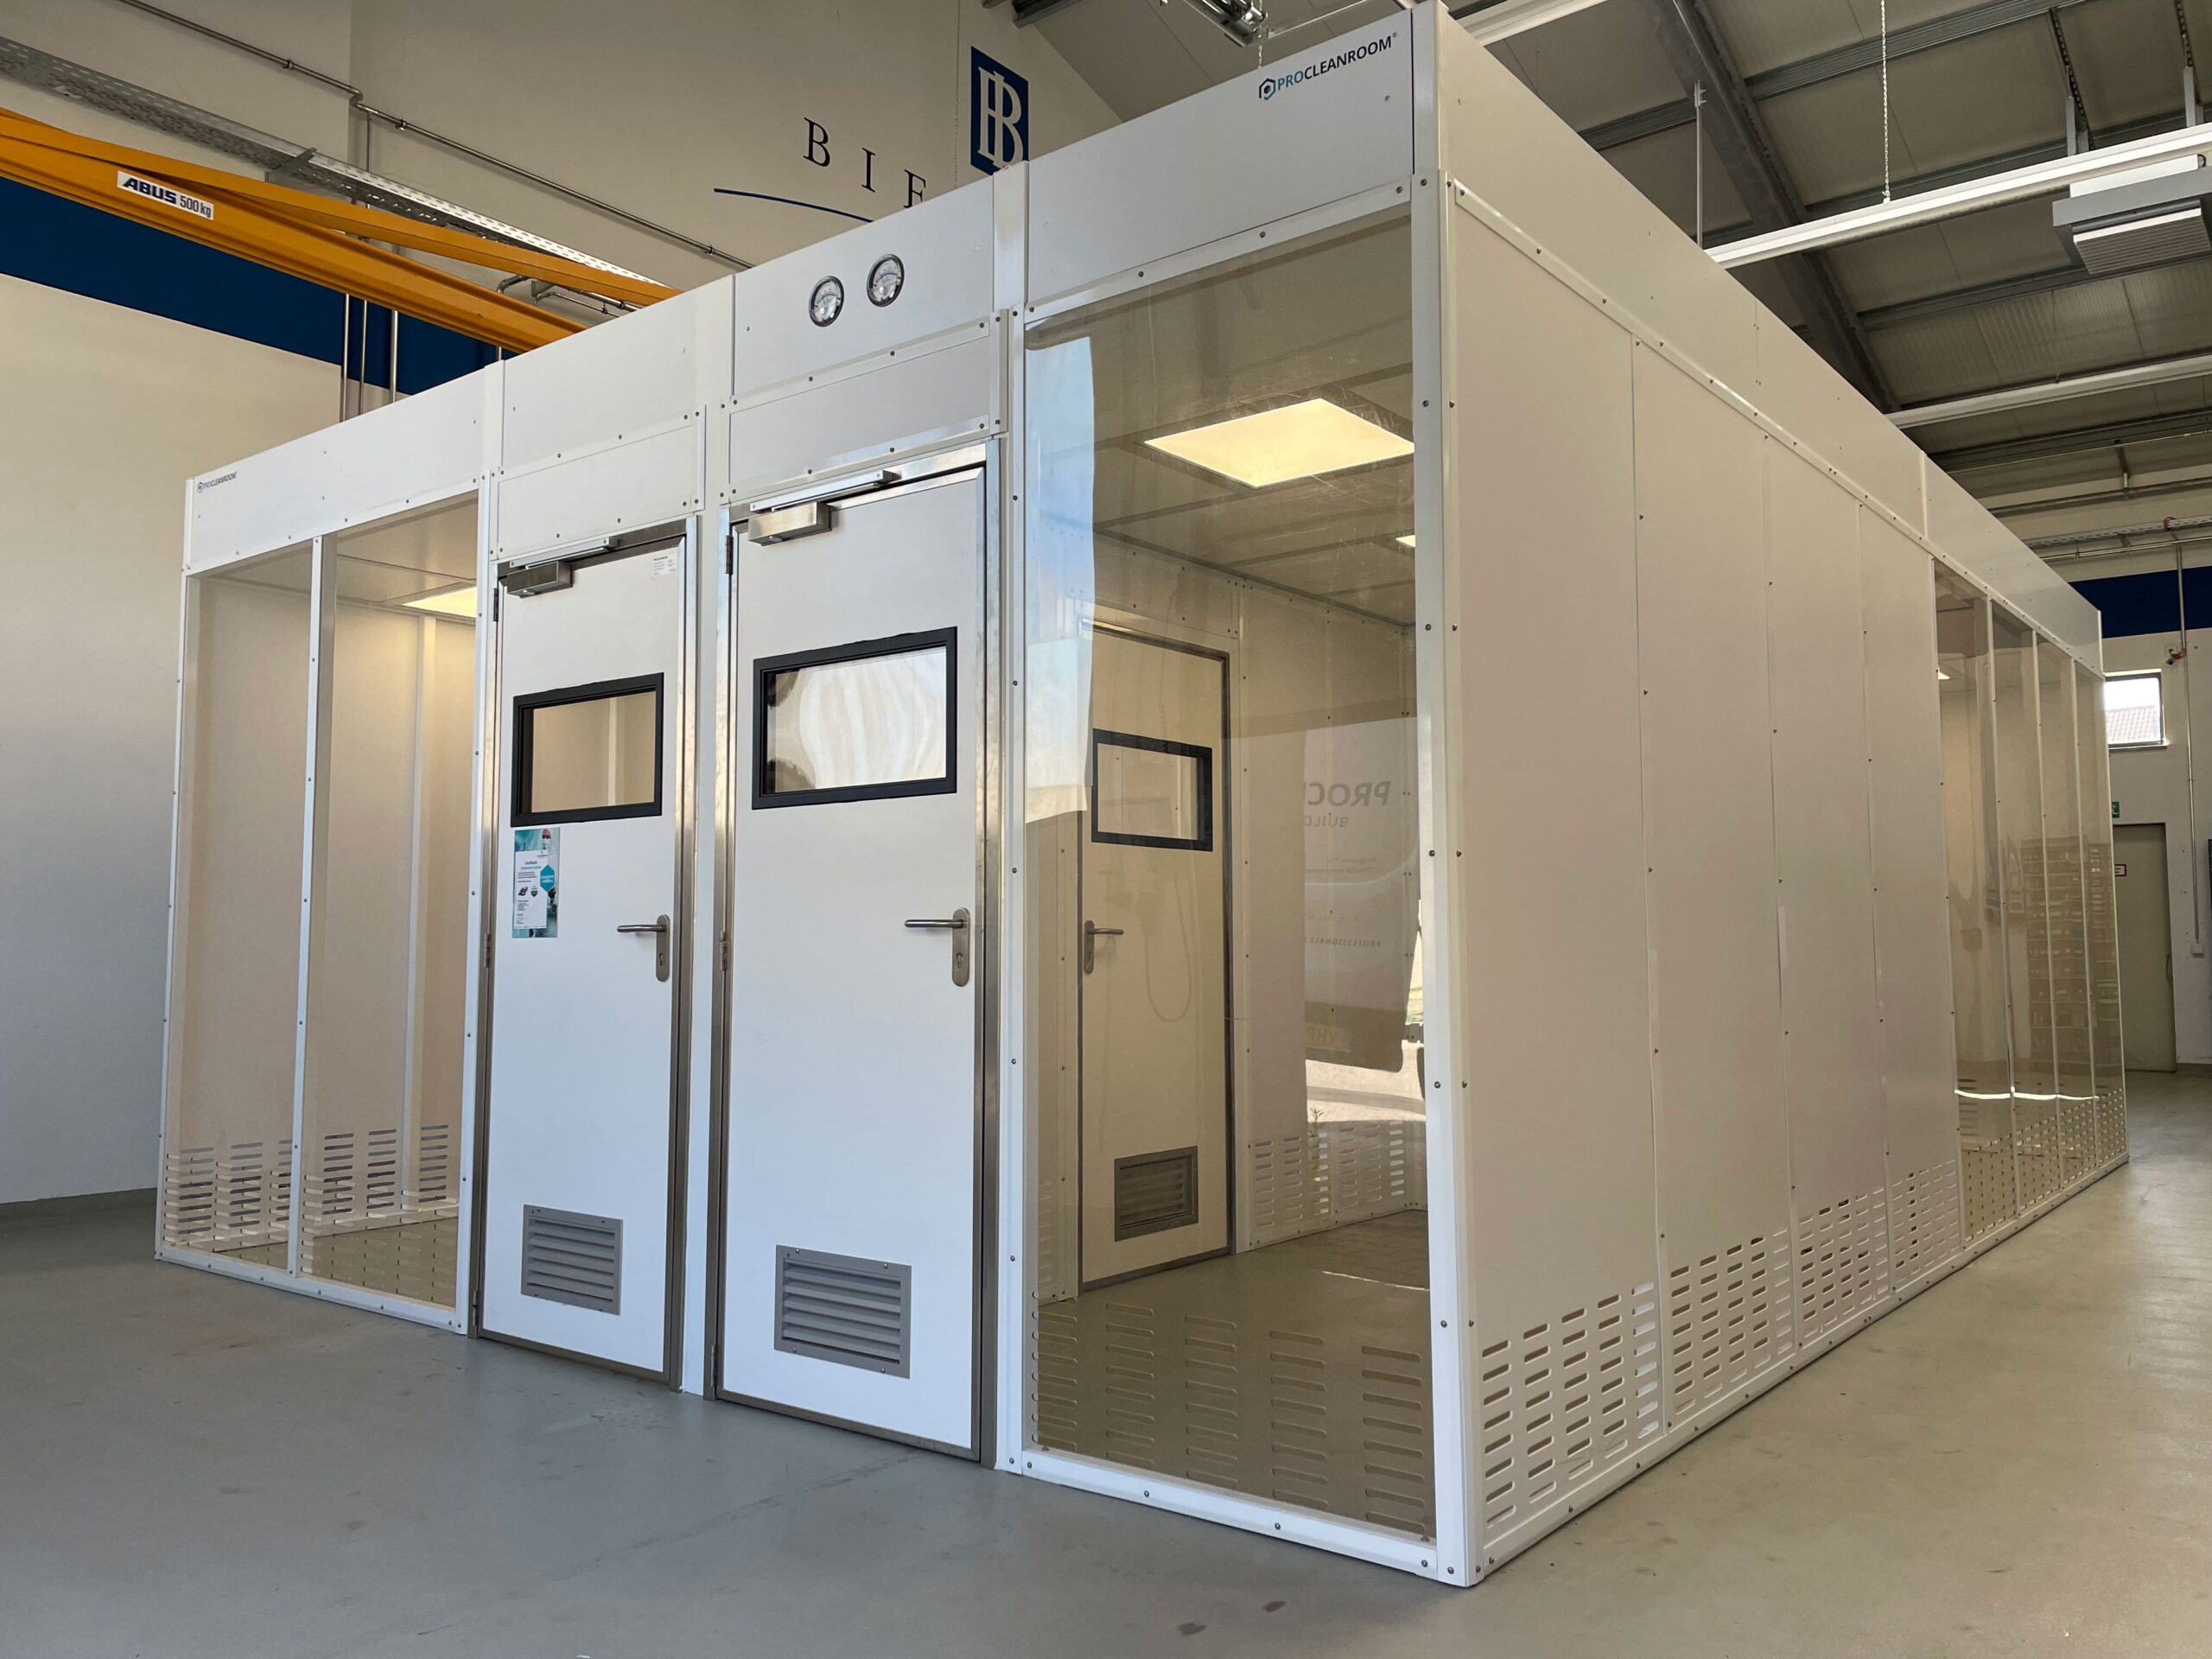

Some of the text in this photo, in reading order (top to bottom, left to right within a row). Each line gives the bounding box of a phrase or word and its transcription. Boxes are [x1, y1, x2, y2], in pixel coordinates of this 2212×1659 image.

[1277, 35, 1391, 90] PROCLEANROOM
[123, 177, 212, 218] ABUS 500 kg
